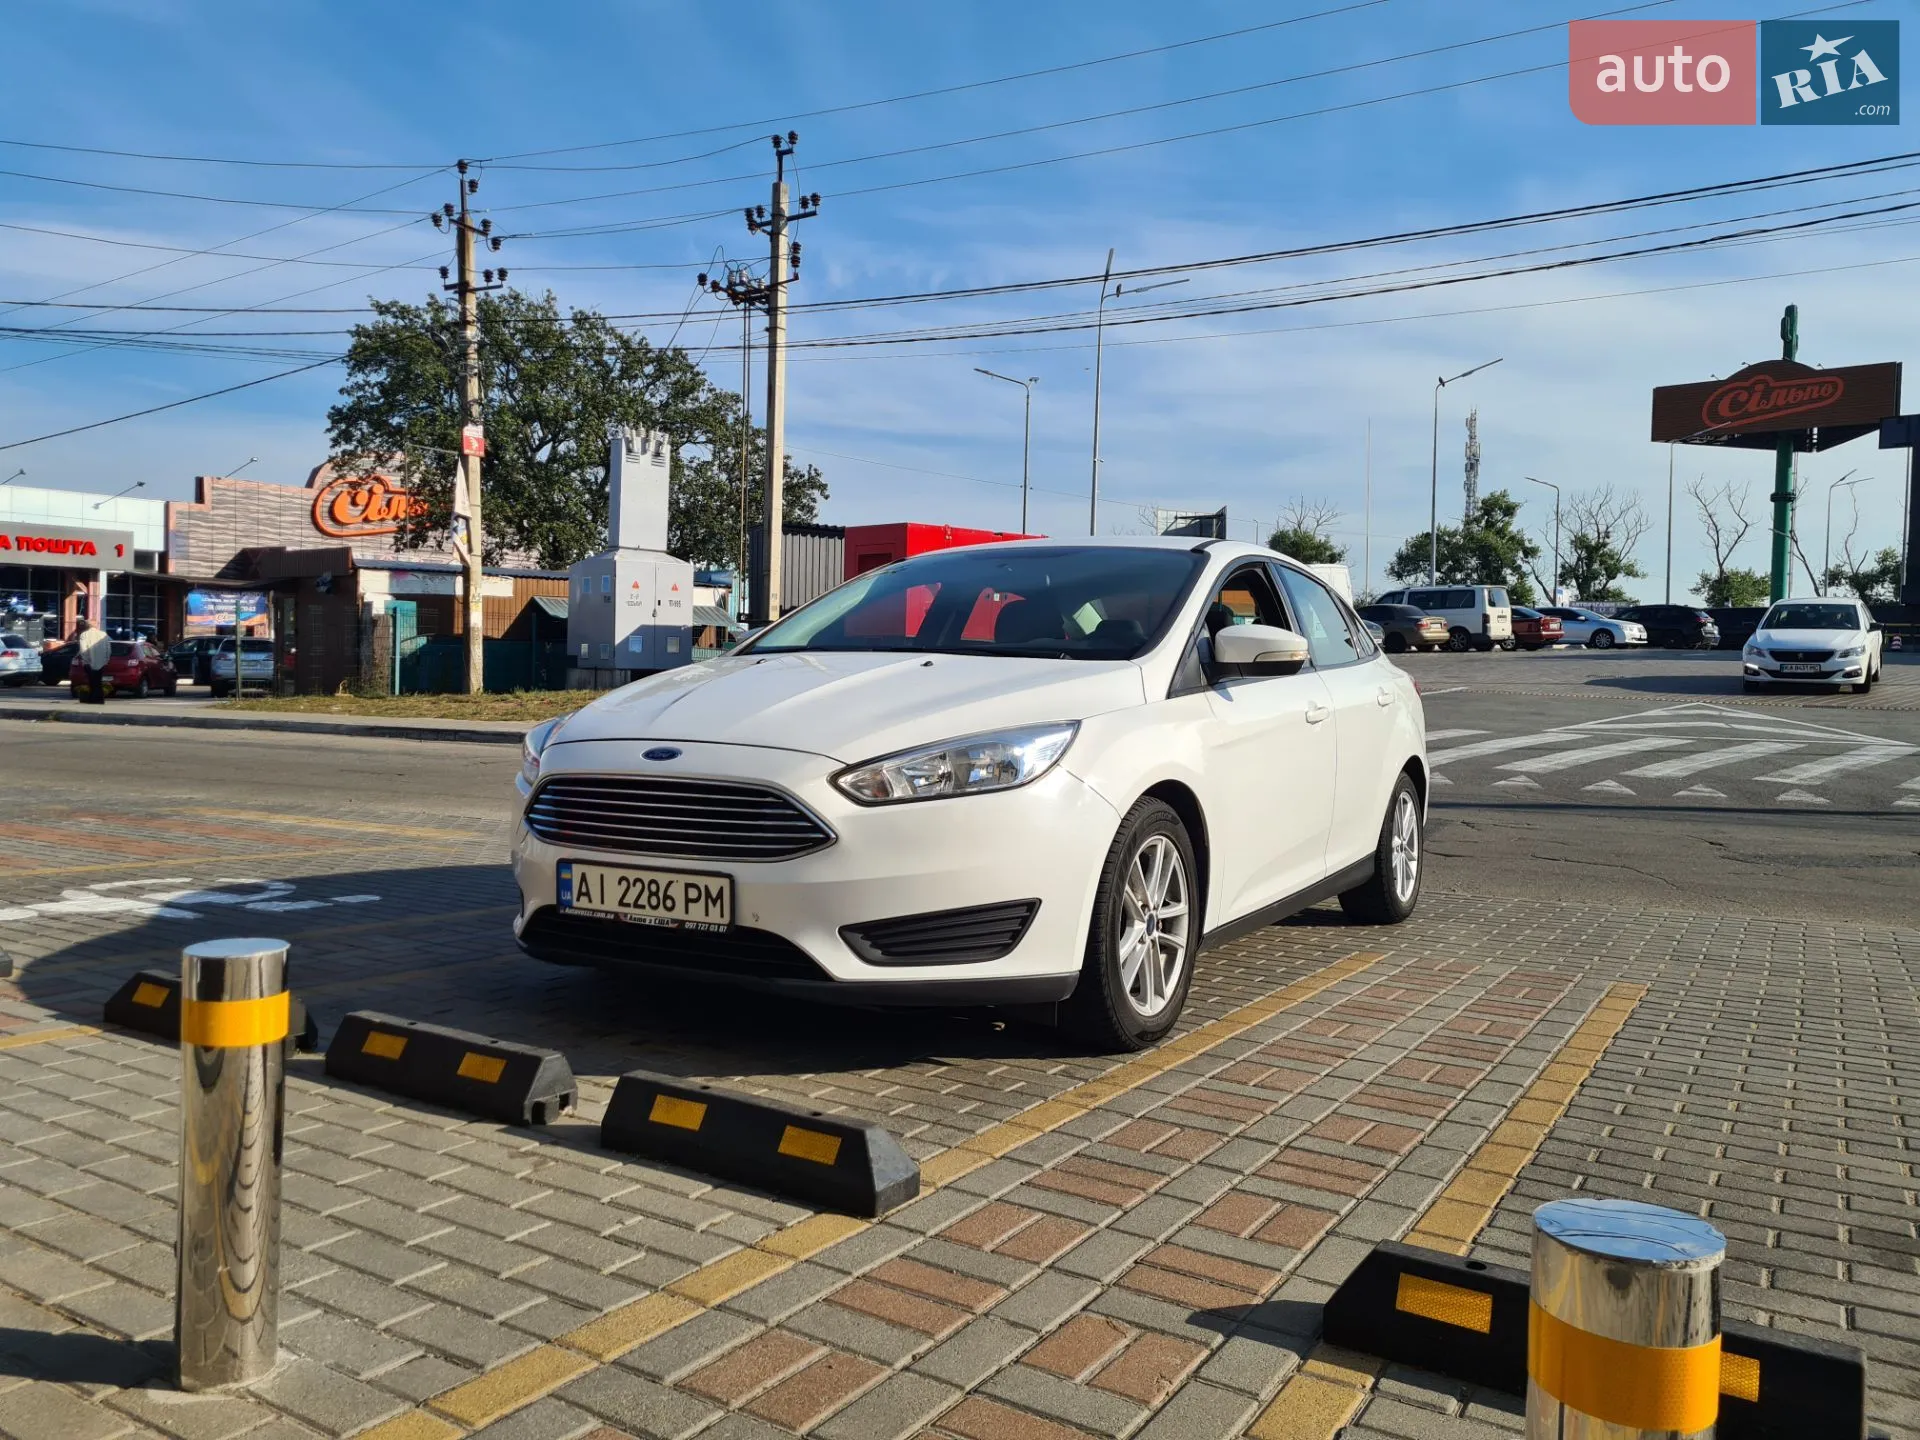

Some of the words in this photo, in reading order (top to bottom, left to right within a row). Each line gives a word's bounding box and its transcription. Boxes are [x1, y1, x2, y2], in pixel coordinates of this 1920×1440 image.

[1718, 382, 1833, 418] Сільпо
[15, 536, 97, 556] ПОШТА
[114, 544, 124, 558] 1
[561, 889, 572, 900] UA
[575, 872, 605, 905] AI
[617, 875, 677, 912] 2286
[684, 882, 725, 919] PM
